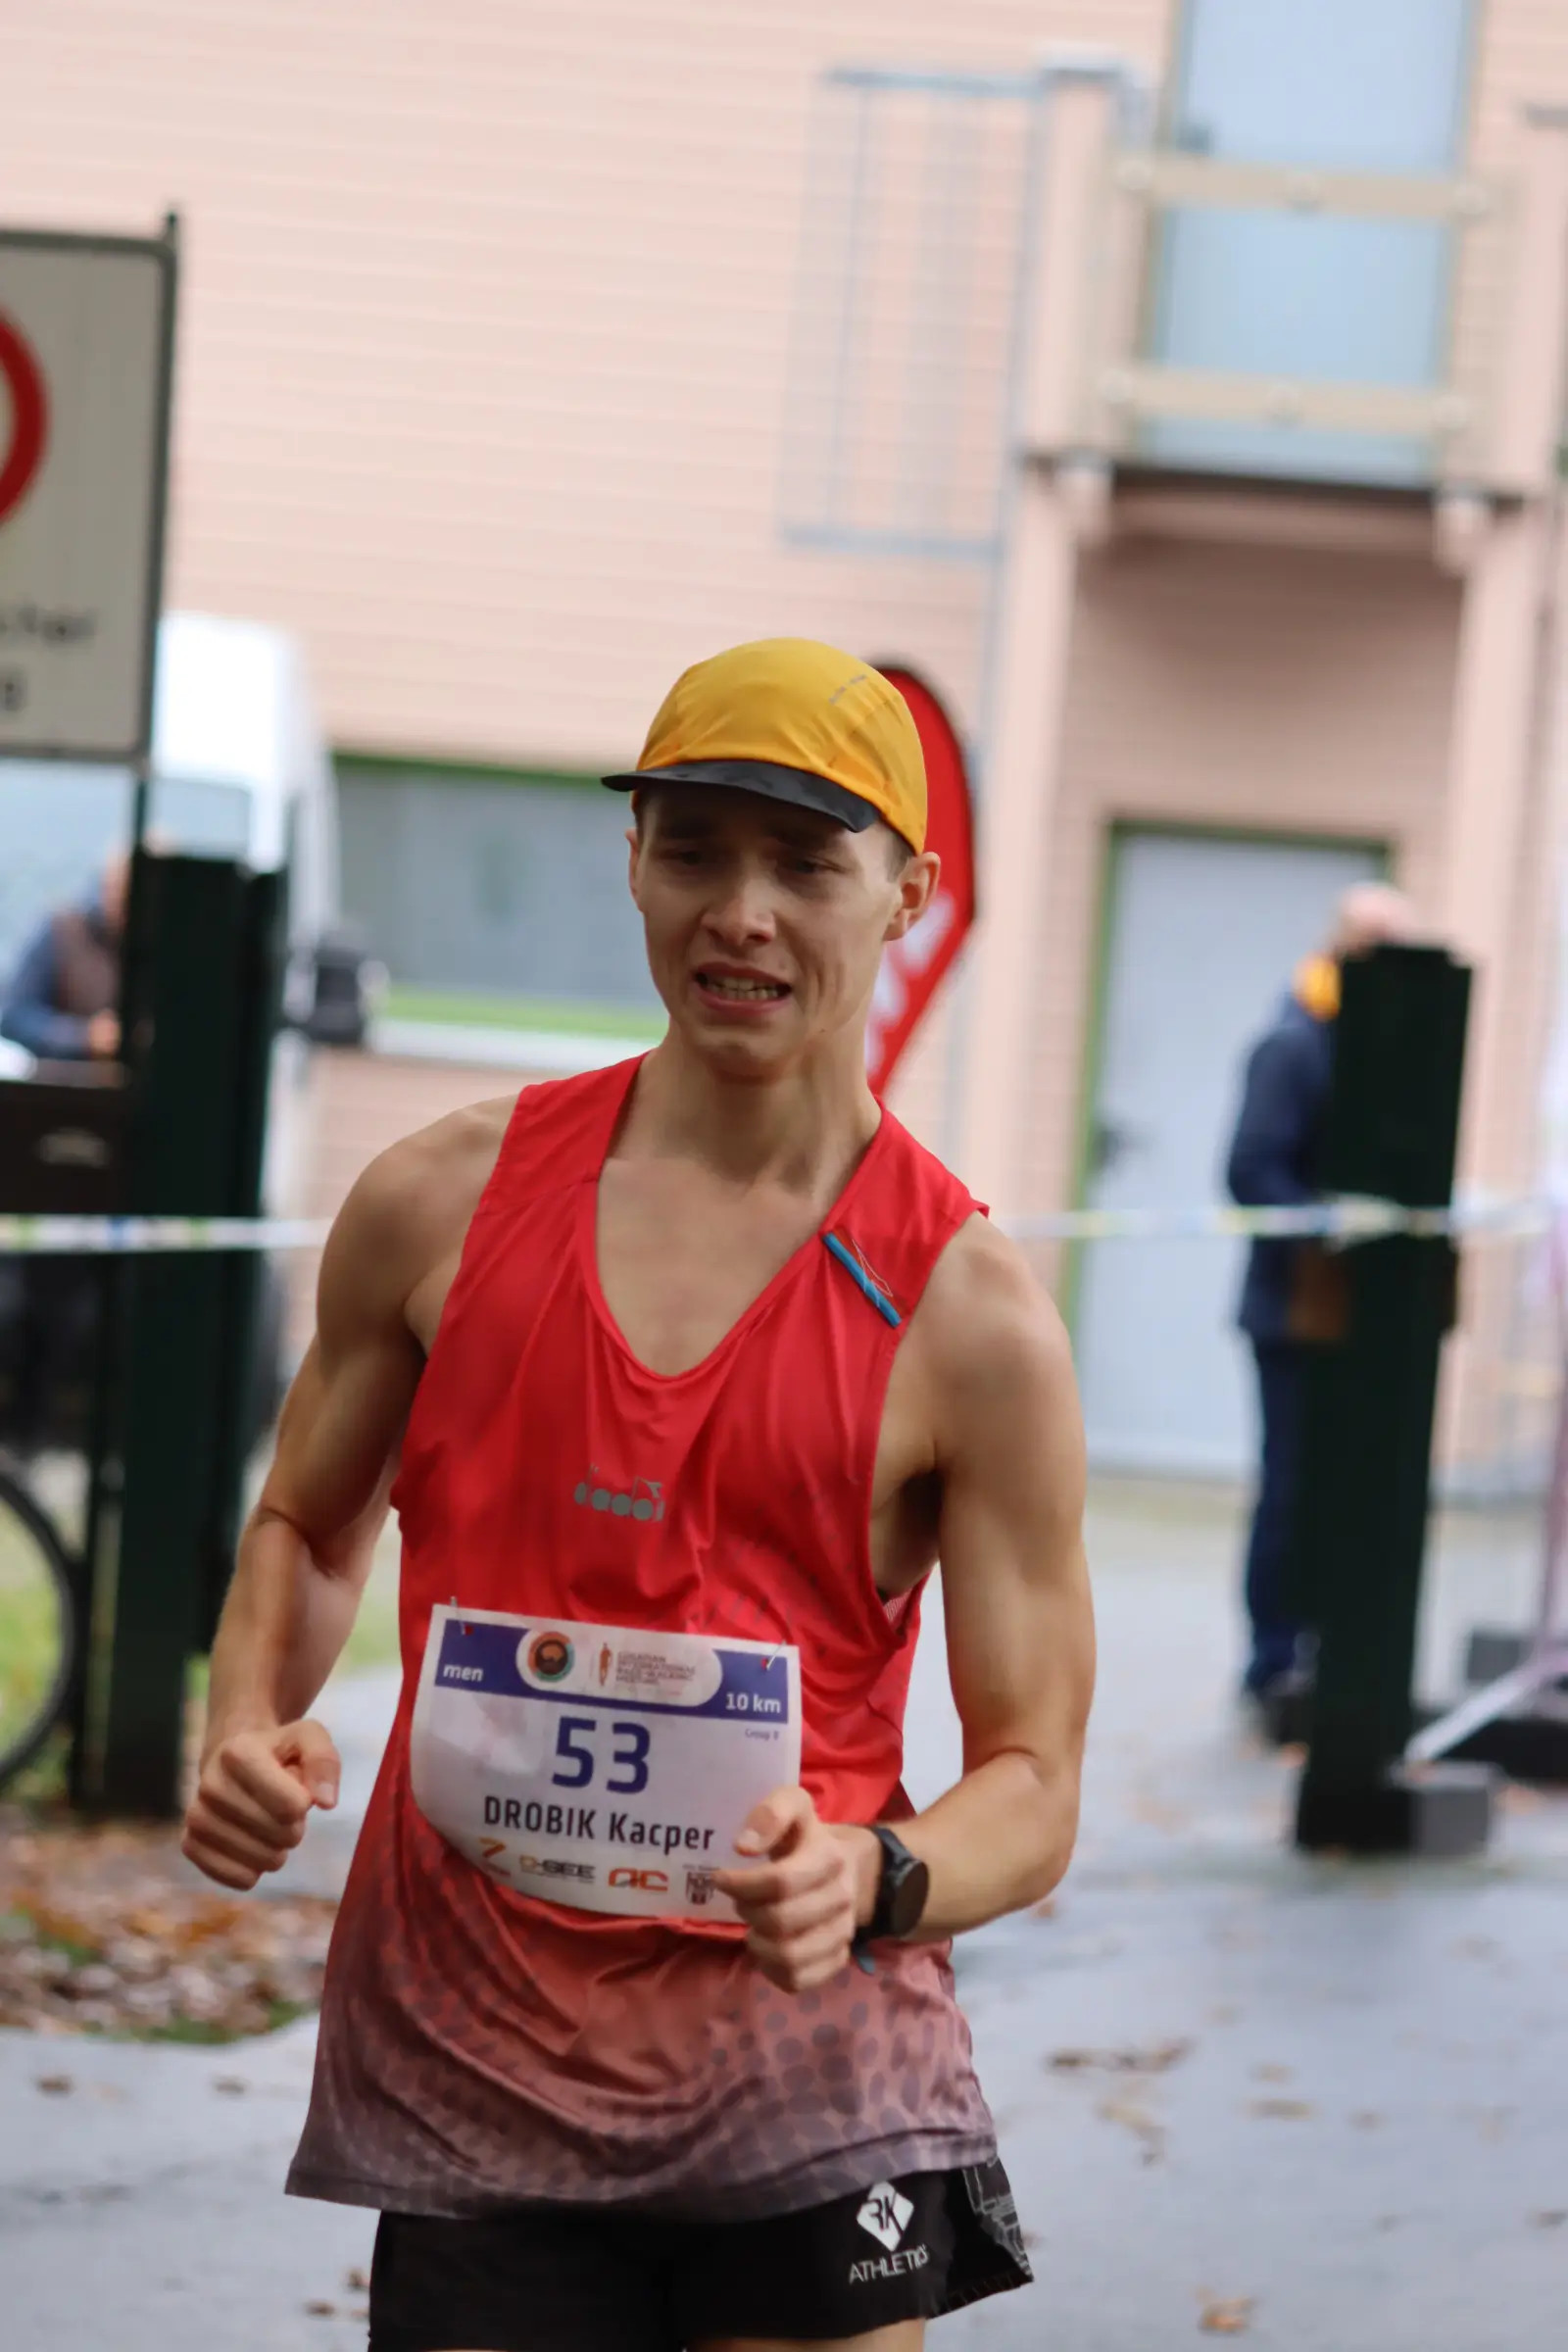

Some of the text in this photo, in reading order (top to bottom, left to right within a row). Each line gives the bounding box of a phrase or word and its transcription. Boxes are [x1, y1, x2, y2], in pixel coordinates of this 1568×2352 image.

[443, 1662, 484, 1683] men
[725, 1691, 782, 1714] 10 km
[551, 1715, 651, 1794] 53
[484, 1795, 715, 1856] DROBIK Kacper
